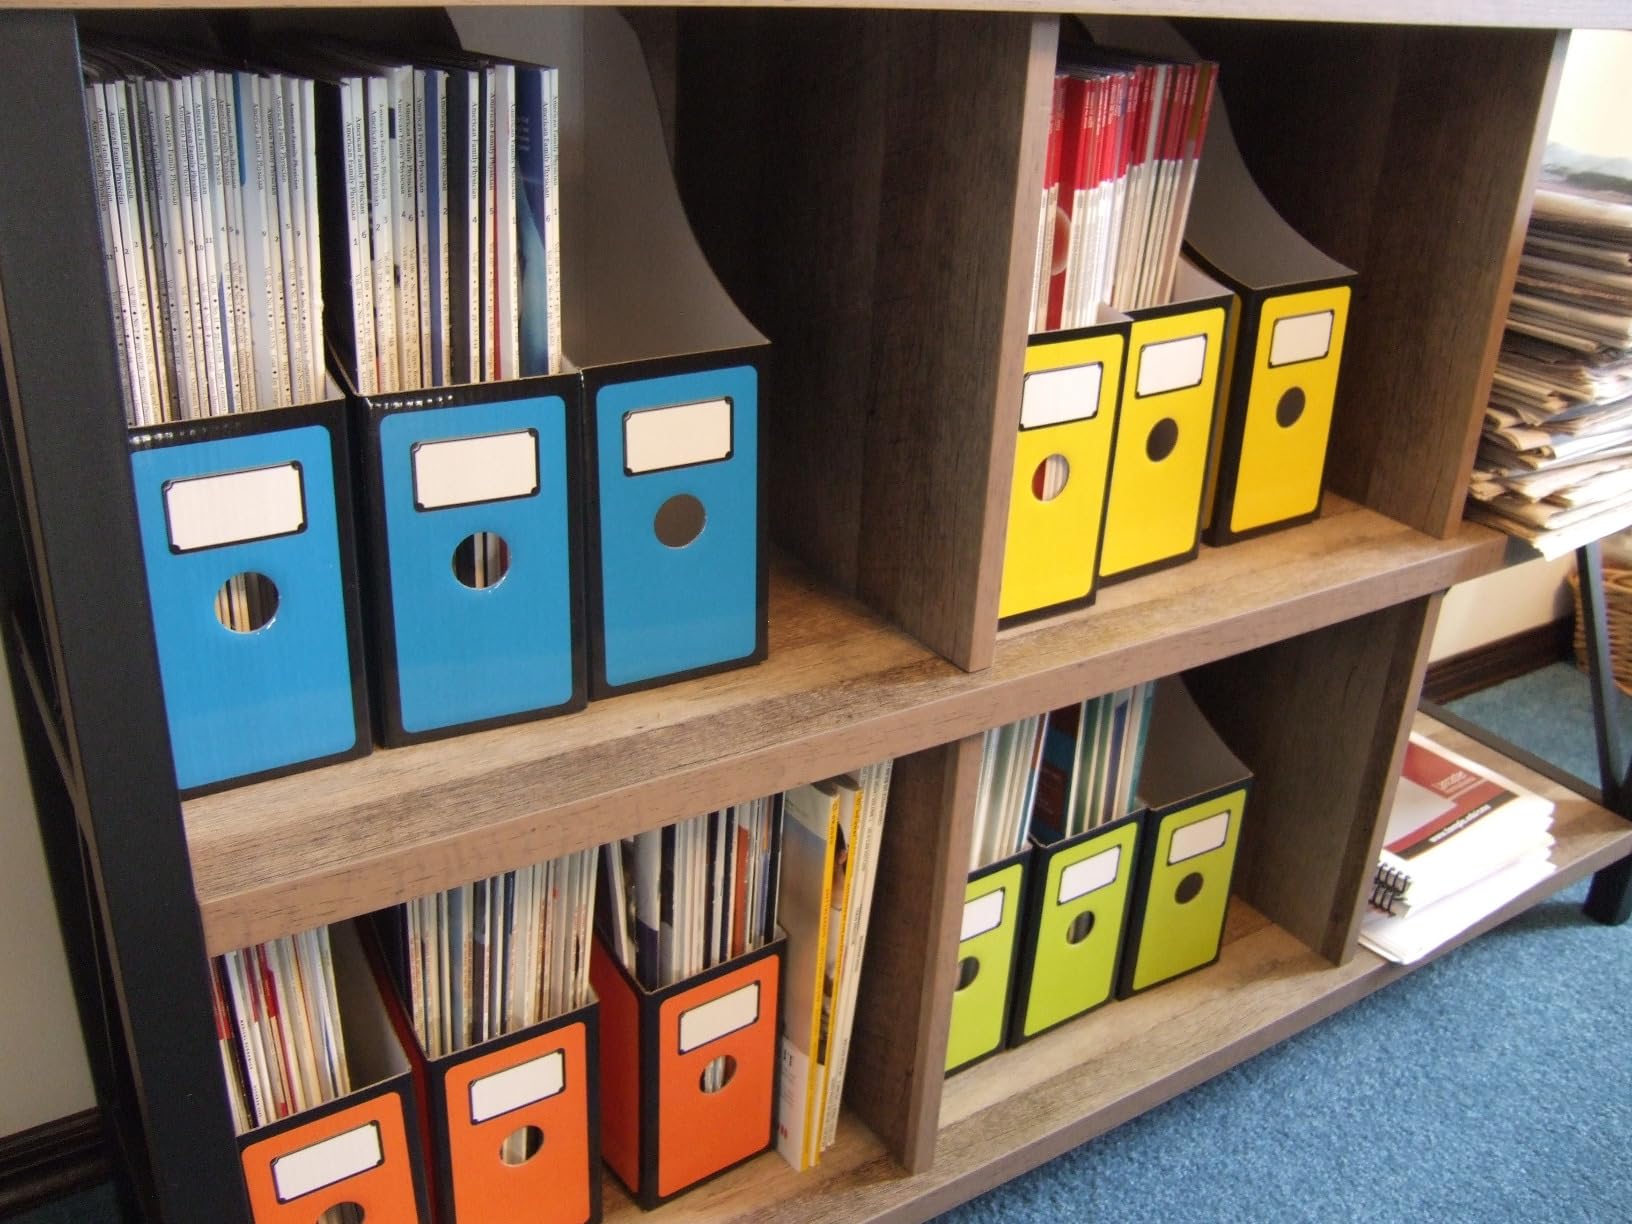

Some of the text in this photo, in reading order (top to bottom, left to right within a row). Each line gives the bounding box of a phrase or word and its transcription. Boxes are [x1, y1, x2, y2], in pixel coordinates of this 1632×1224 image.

[165, 115, 173, 147] American
[186, 111, 194, 143] American
[211, 131, 219, 153] Family
[98, 108, 113, 202] American Family Physician
[110, 112, 118, 145] American
[116, 173, 124, 205] Physician
[197, 139, 205, 161] Family
[126, 168, 134, 199] Physician
[200, 163, 208, 195] Physician
